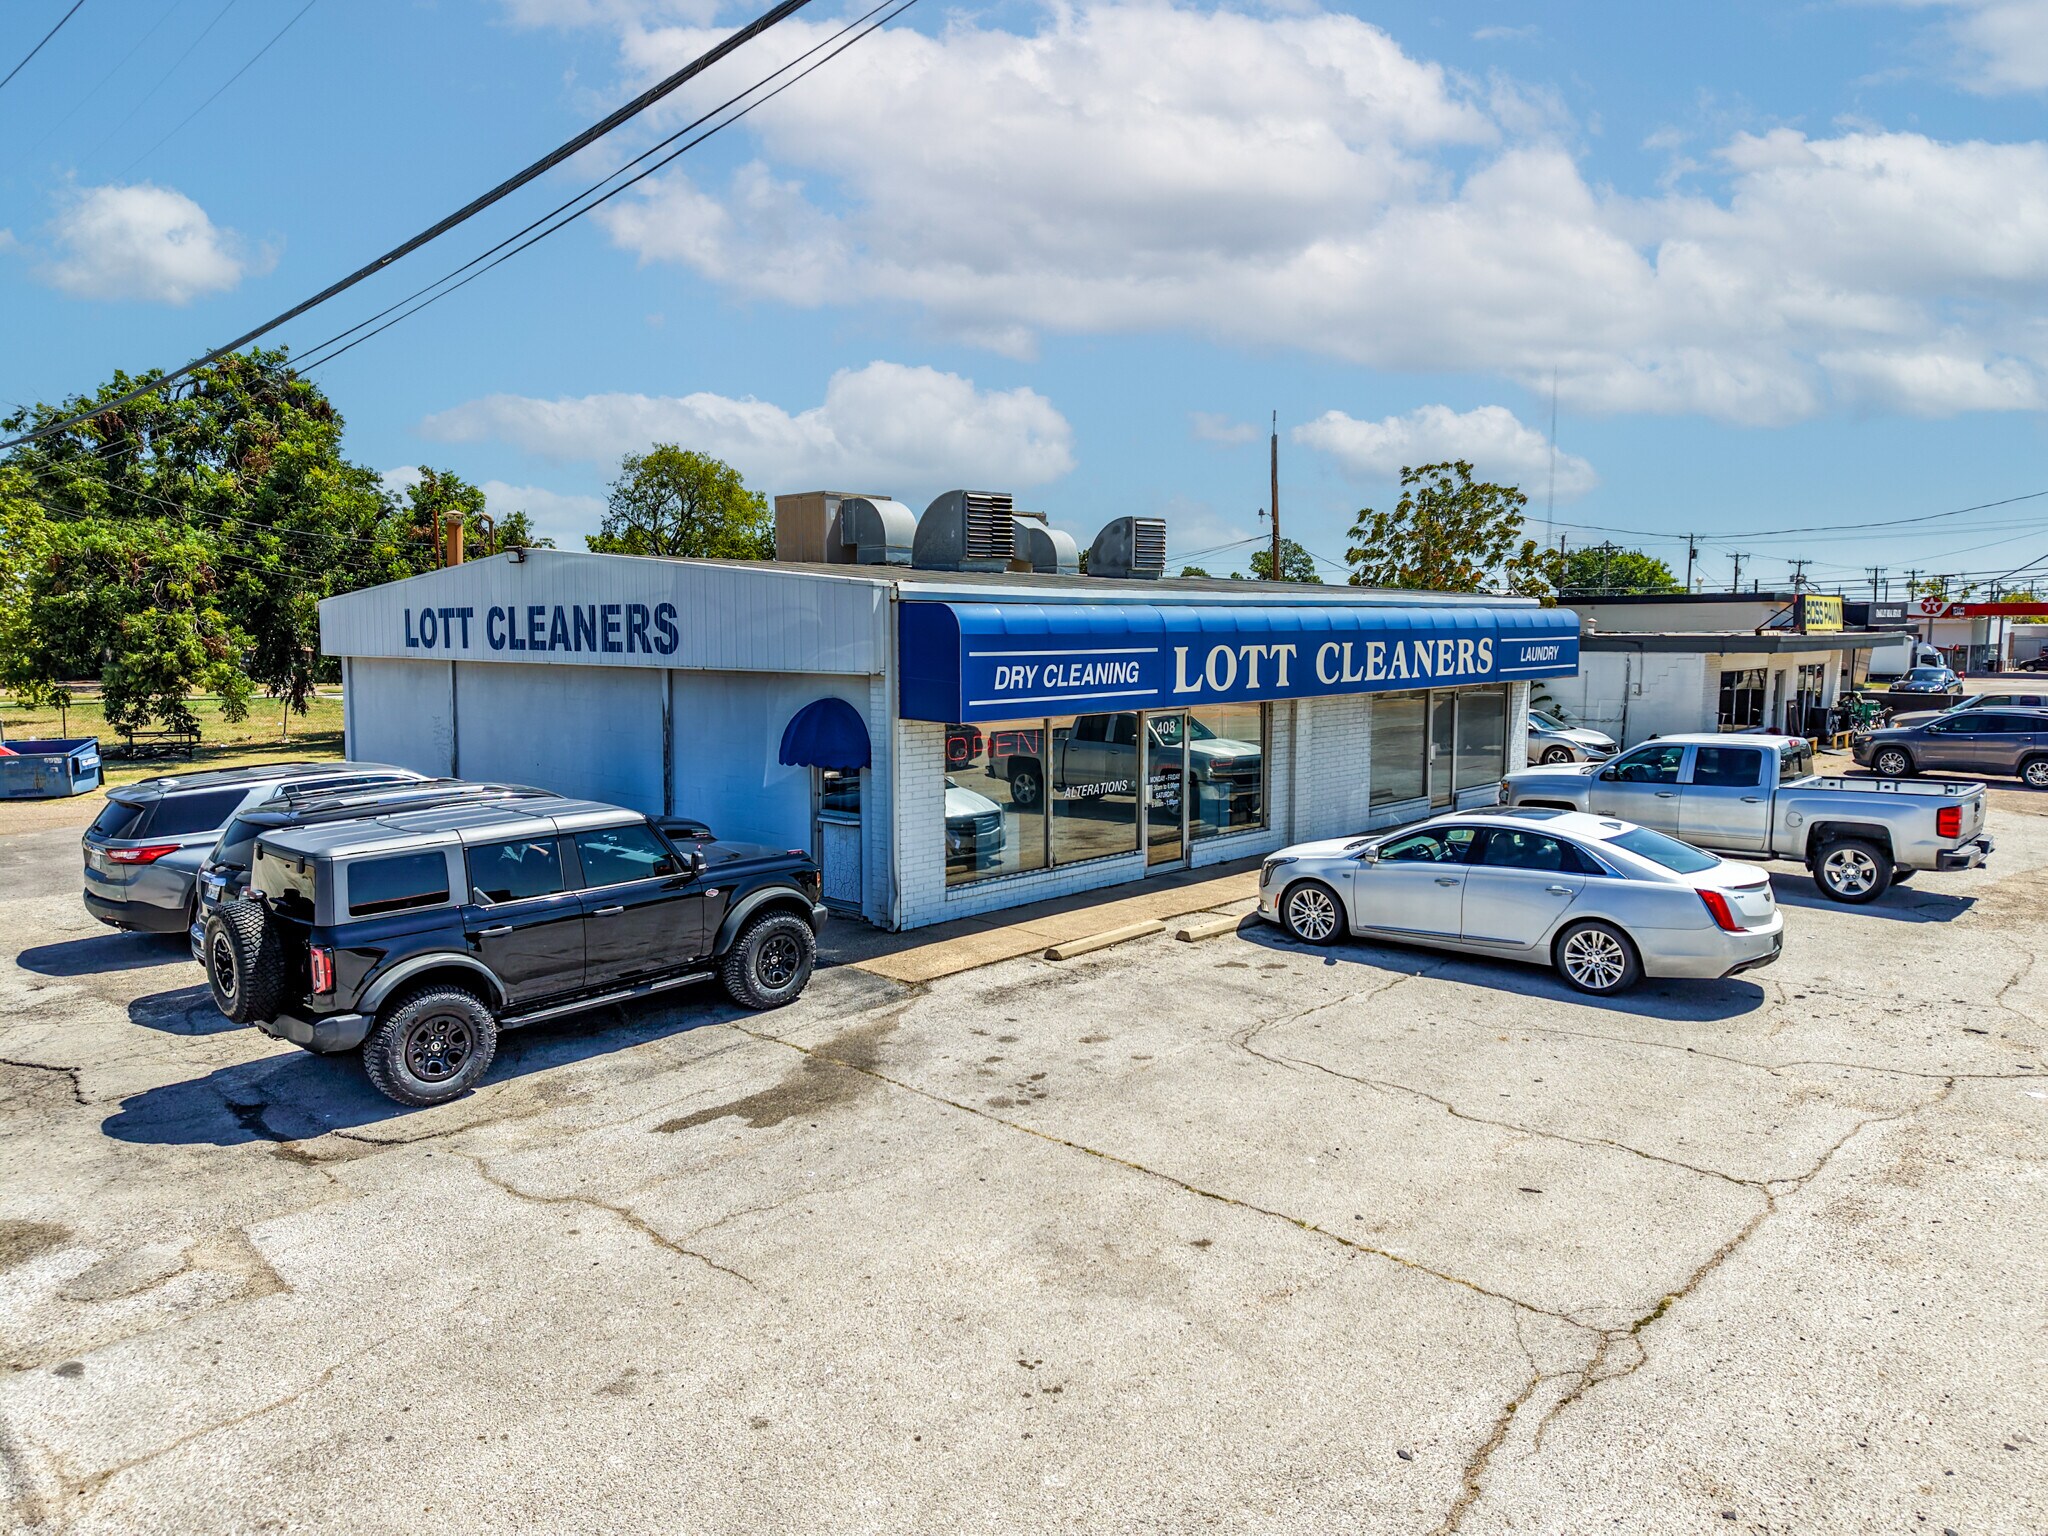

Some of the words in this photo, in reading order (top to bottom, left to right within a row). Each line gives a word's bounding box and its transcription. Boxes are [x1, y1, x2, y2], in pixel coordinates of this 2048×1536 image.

[1807, 601, 1823, 625] BOSS
[1824, 602, 1843, 625] PAWN
[405, 606, 474, 649] LOTT
[486, 602, 679, 655] CLEANERS
[1520, 645, 1560, 663] LAUNDRY
[994, 664, 1039, 691] DRY
[1043, 661, 1140, 688] CLEANING
[1172, 643, 1297, 694] LOTT
[1315, 637, 1494, 685] CLEANERS
[1156, 720, 1176, 735] 408
[947, 730, 1038, 761] OPEN
[1064, 779, 1128, 799] ALTERATIONS
[1150, 775, 1165, 783] MONDAY
[1156, 790, 1174, 799] SATURDAY
